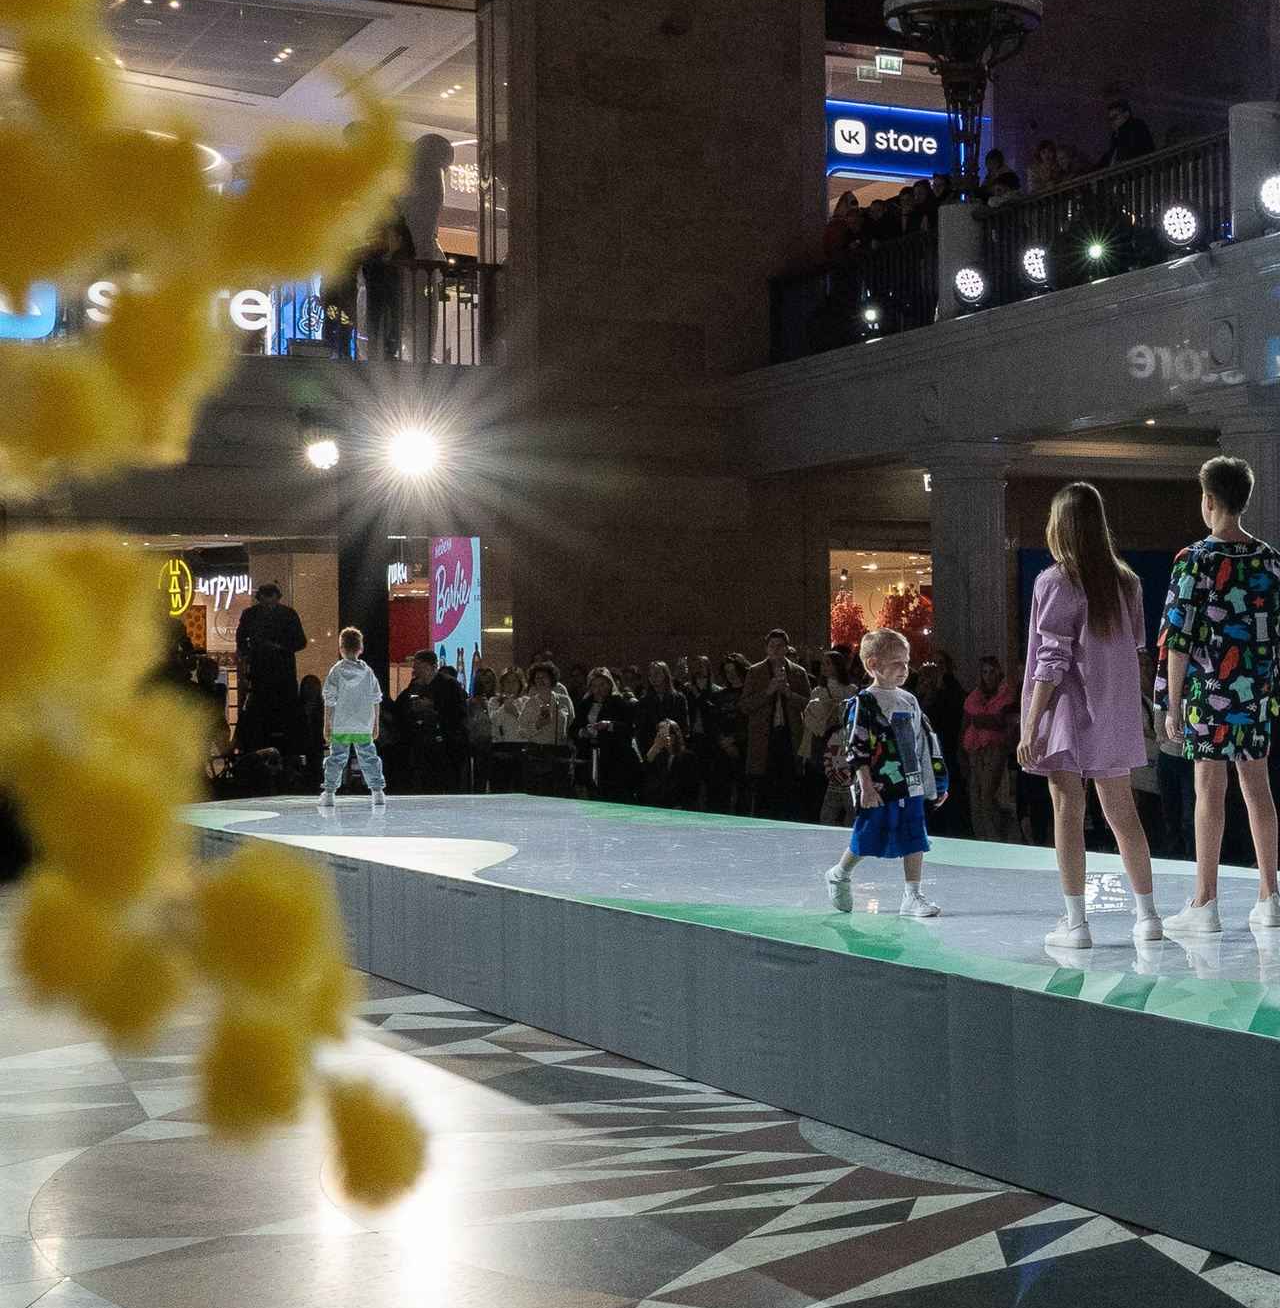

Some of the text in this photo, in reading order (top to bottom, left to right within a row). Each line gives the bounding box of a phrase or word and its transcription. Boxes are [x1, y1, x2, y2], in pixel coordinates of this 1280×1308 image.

[841, 129, 938, 155] VK store
[198, 574, 252, 610] игруш
[435, 560, 471, 625] Barbie
